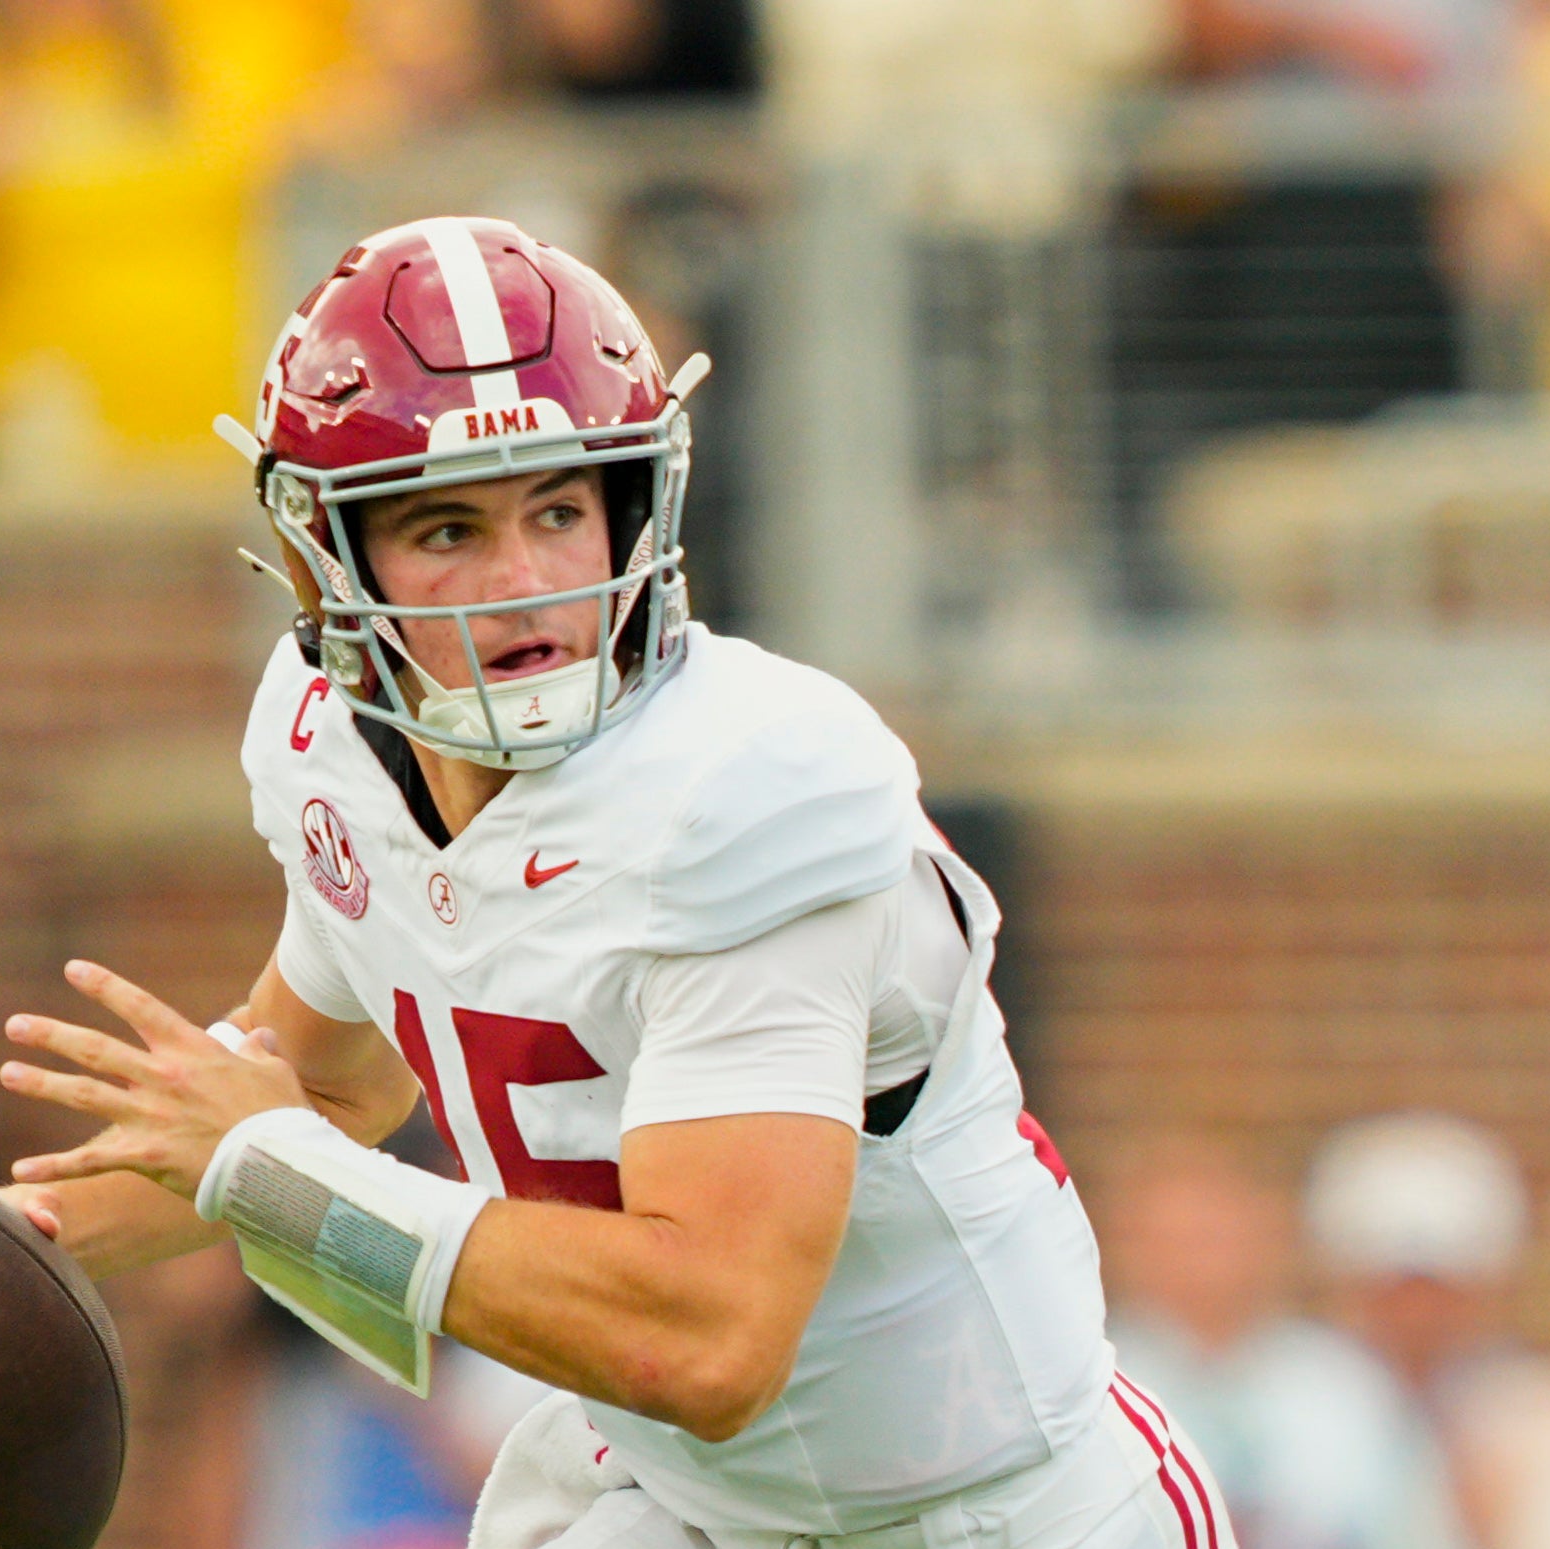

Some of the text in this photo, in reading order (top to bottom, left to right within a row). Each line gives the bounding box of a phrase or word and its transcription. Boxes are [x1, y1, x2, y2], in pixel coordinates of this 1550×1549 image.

[464, 406, 539, 439] BAMA
[617, 534, 654, 613] CRSON
[290, 677, 330, 752] C
[522, 695, 541, 716] A
